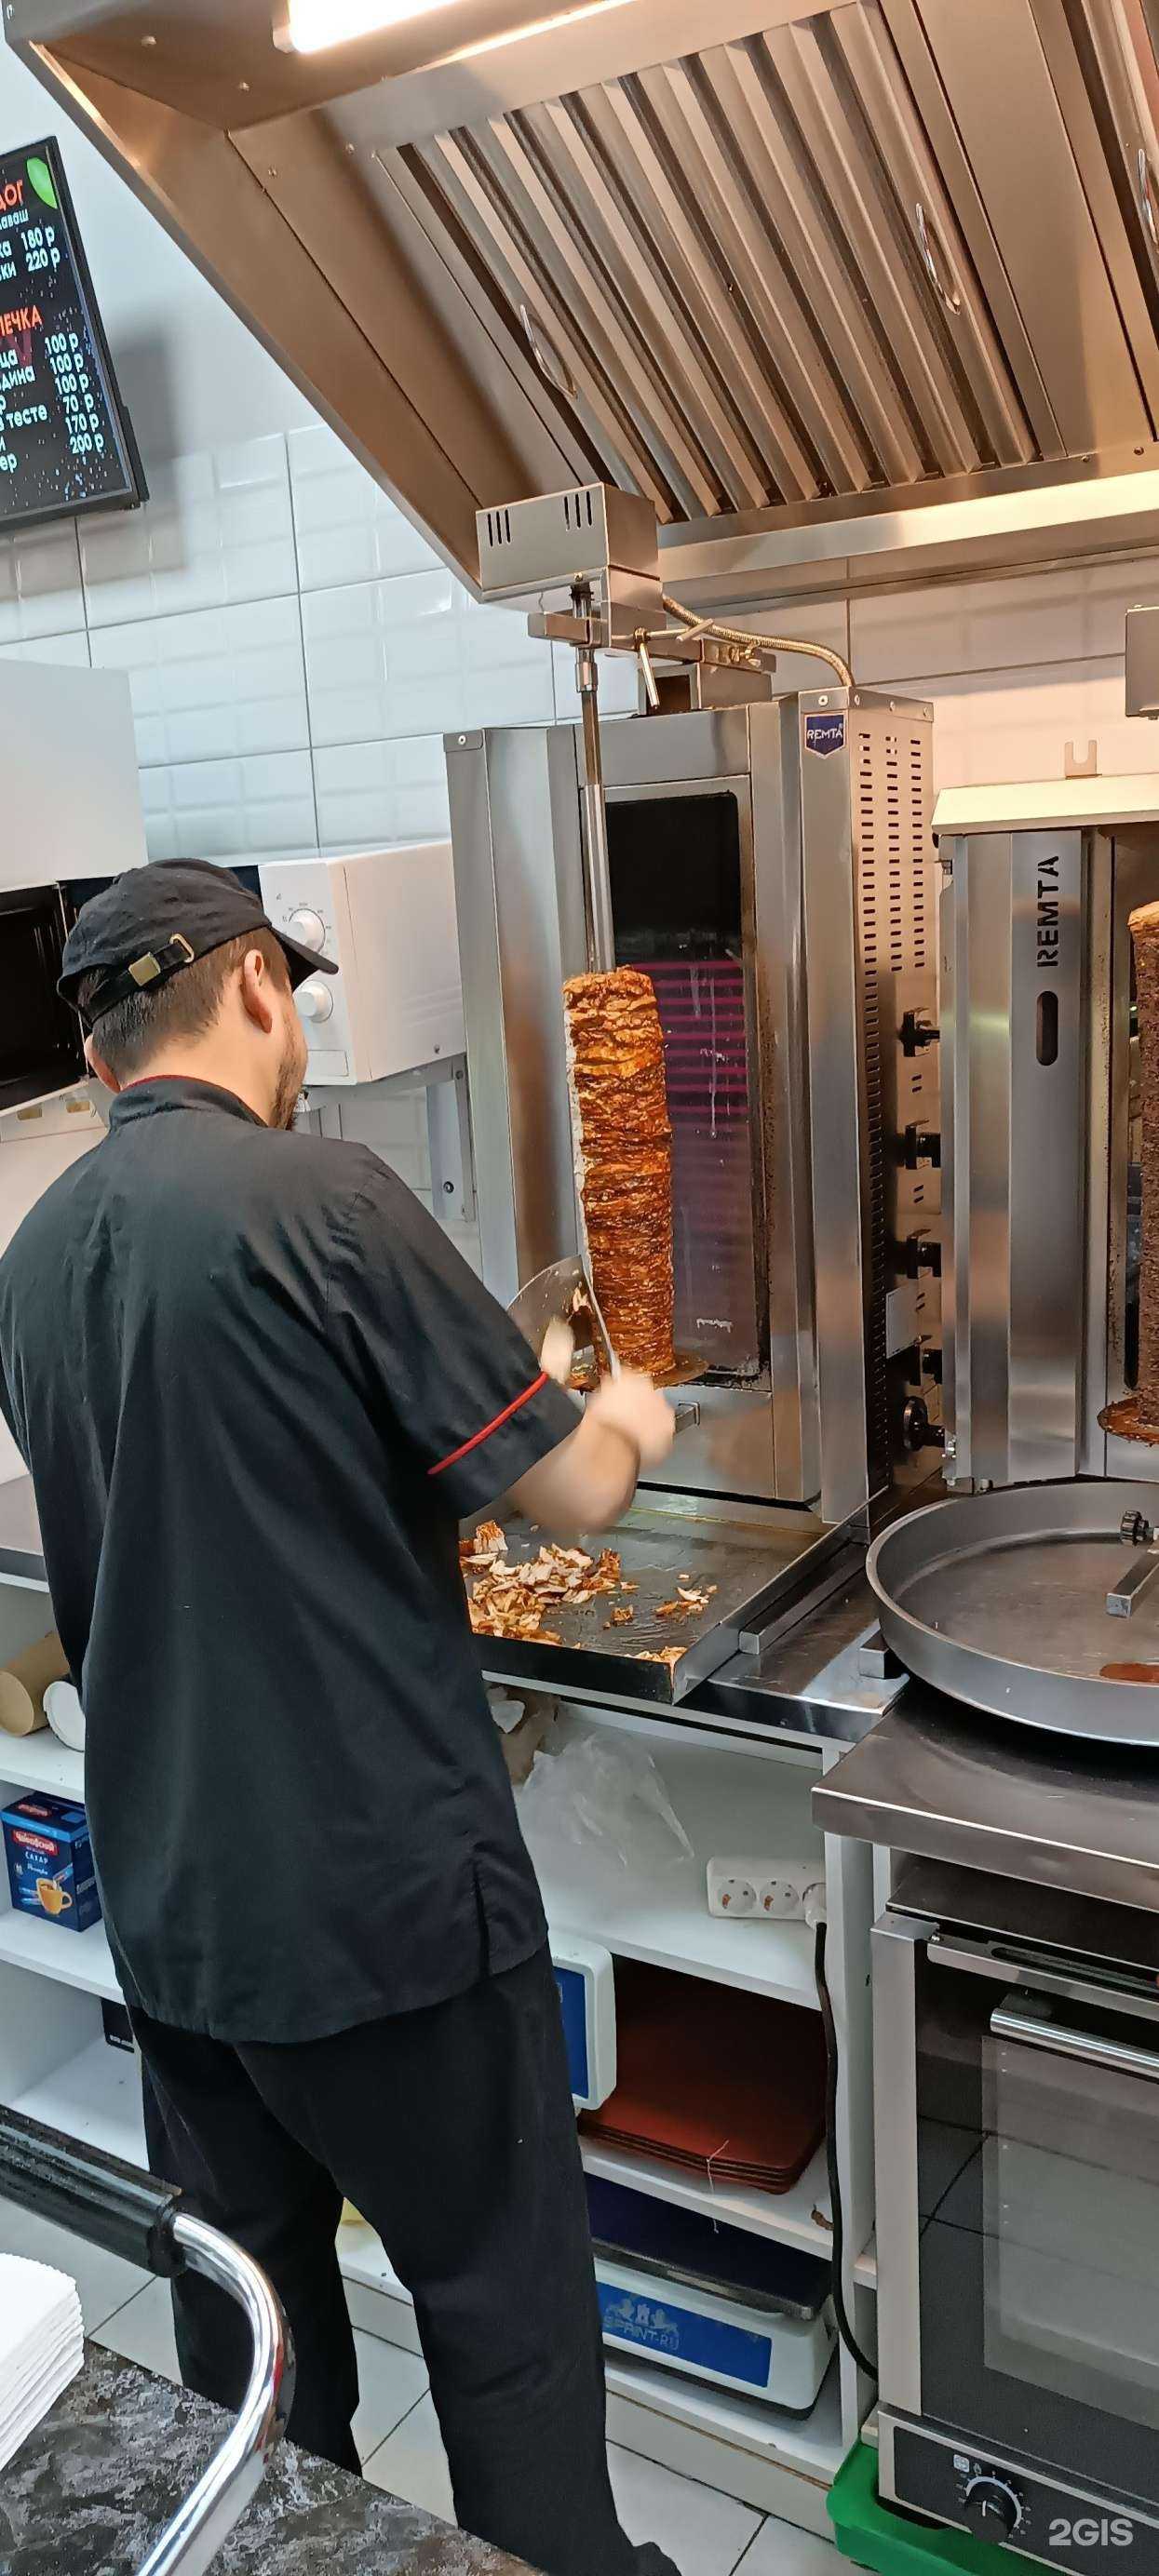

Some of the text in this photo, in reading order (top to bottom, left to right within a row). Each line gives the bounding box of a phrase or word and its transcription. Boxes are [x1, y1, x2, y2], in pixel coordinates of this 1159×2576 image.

[0, 208, 29, 230] аваш
[20, 226, 43, 251] 180
[25, 248, 48, 272] 220
[45, 333, 67, 355] 100
[0, 366, 35, 391] дина
[49, 353, 73, 375] 100
[55, 373, 77, 395] 100
[6, 405, 47, 429] тесте
[62, 394, 79, 414] 70
[65, 412, 88, 435] 170
[70, 432, 92, 454] 200
[807, 728, 843, 740] REMTA
[1037, 856, 1058, 967] REMTA
